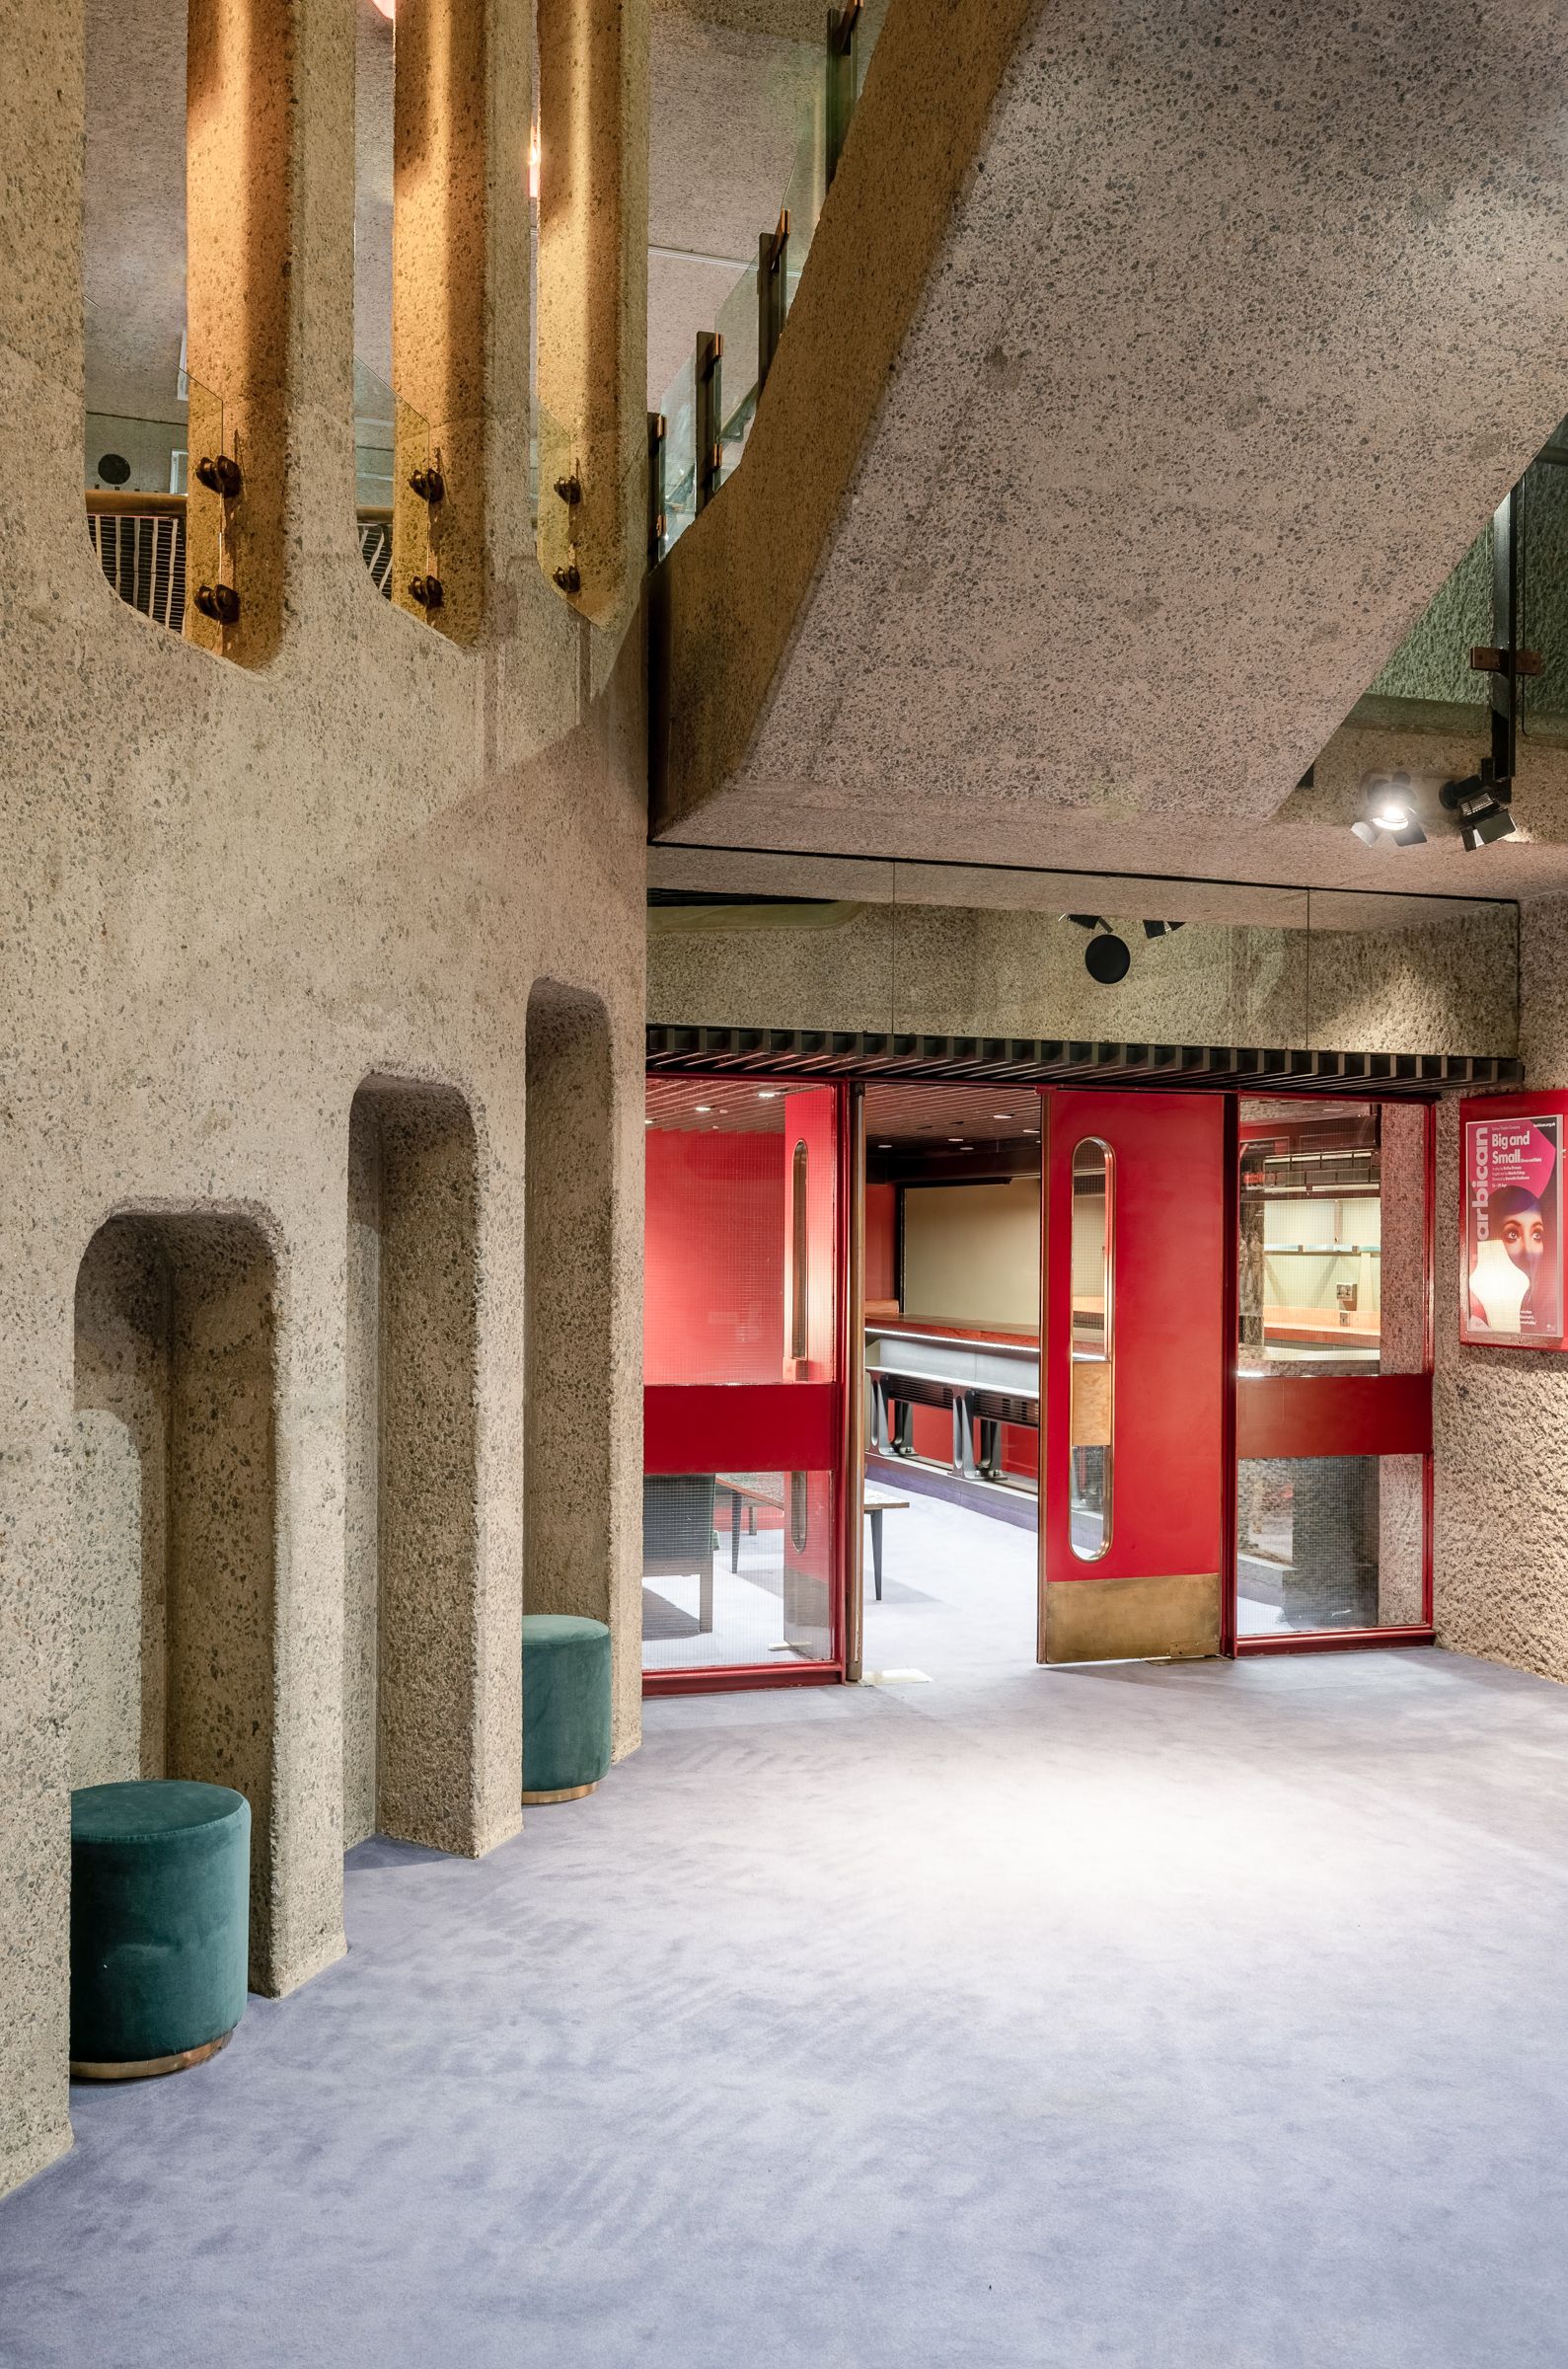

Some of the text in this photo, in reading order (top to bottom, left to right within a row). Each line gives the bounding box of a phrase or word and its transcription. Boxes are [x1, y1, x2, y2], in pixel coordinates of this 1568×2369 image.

[1492, 1130, 1531, 1150] Big and
[1492, 1149, 1521, 1164] Small
[1471, 1127, 1489, 1261] arbican
